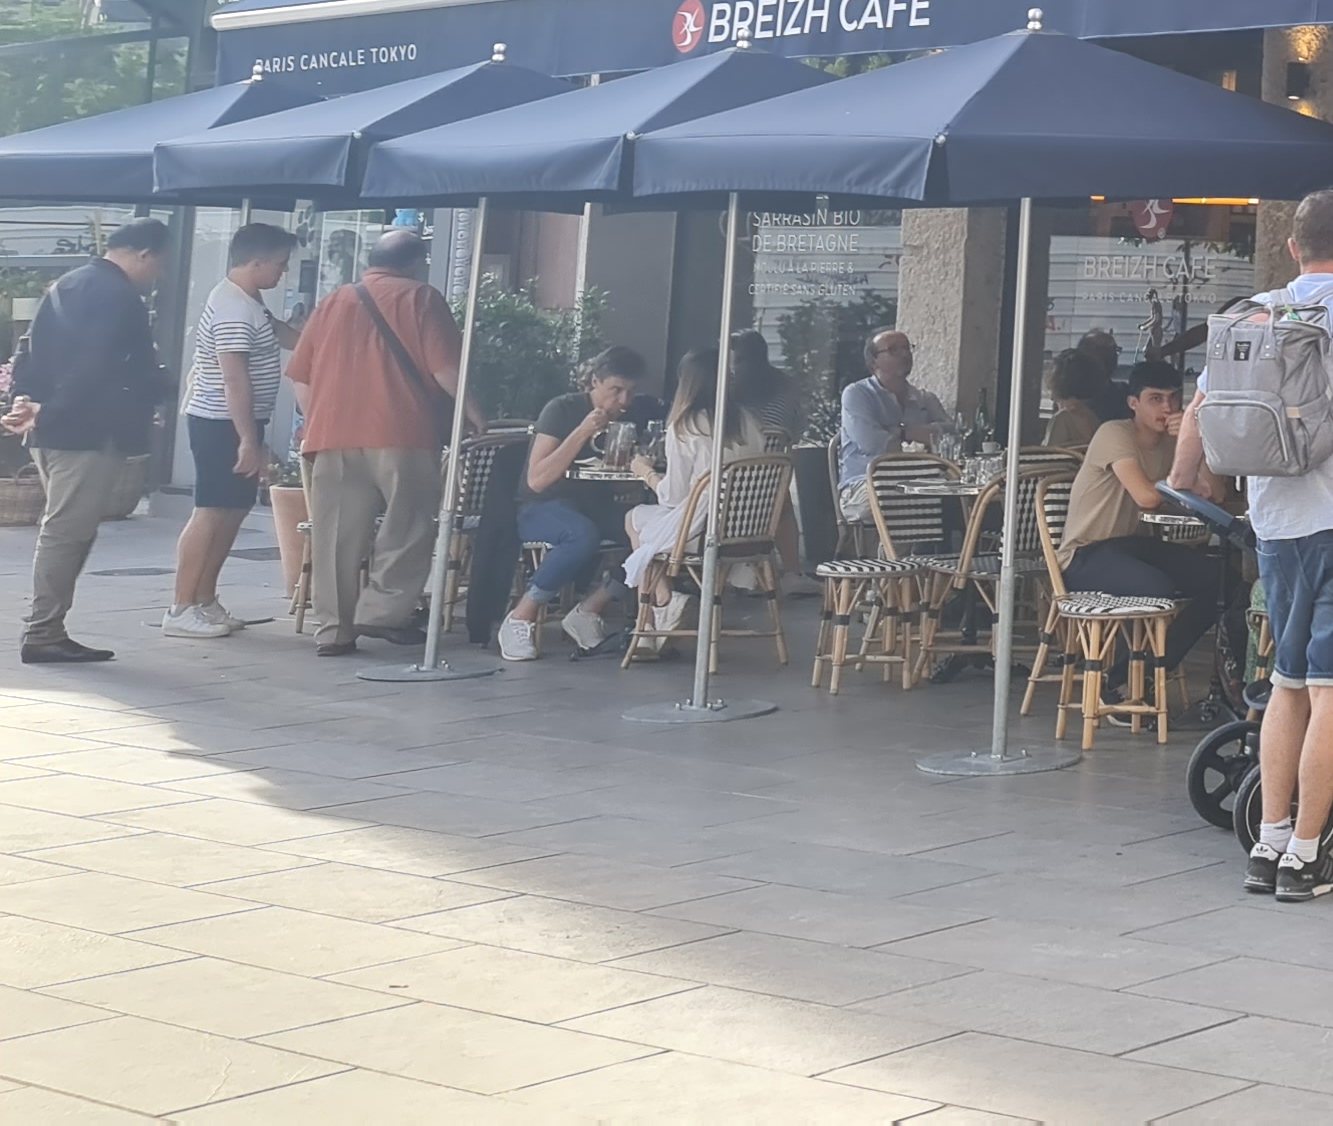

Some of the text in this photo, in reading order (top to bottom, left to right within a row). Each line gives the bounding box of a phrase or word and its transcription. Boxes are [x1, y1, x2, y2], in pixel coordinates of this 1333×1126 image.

[300, 49, 366, 71] CANCALE
[370, 43, 418, 64] TOKYO
[752, 208, 828, 227] SARRASIN
[752, 233, 860, 253] DE BRETAGNE
[810, 261, 845, 274] PIERRE
[1084, 255, 1217, 279] BREIZH CAFE
[790, 283, 816, 296] SANS
[817, 283, 857, 297] GLUTEN
[1082, 290, 1218, 304] PARIS CANCALE TOKYO
